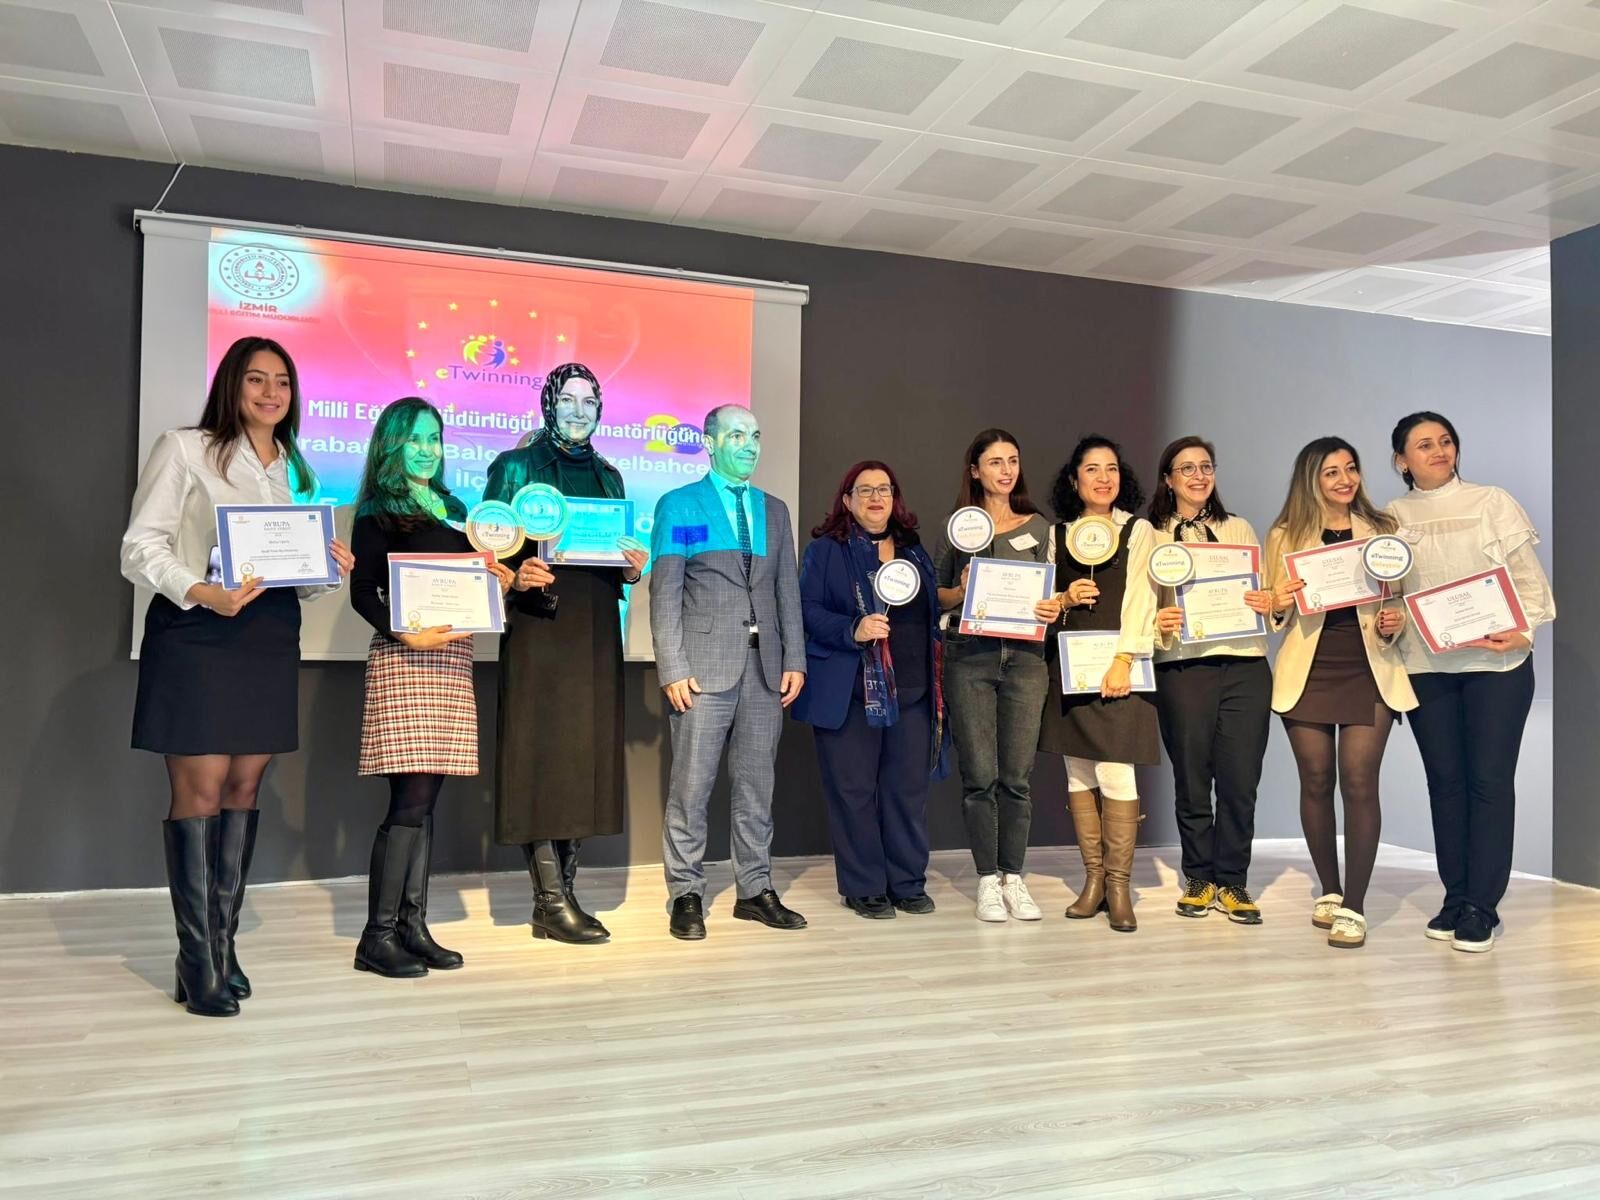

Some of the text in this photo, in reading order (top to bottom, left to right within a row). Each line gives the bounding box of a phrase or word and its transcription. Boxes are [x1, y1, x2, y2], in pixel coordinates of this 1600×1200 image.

[239, 300, 278, 313] İZMİR
[435, 365, 543, 391] eTwinning
[308, 399, 349, 419] Milli
[438, 405, 533, 434] üdürlüğü
